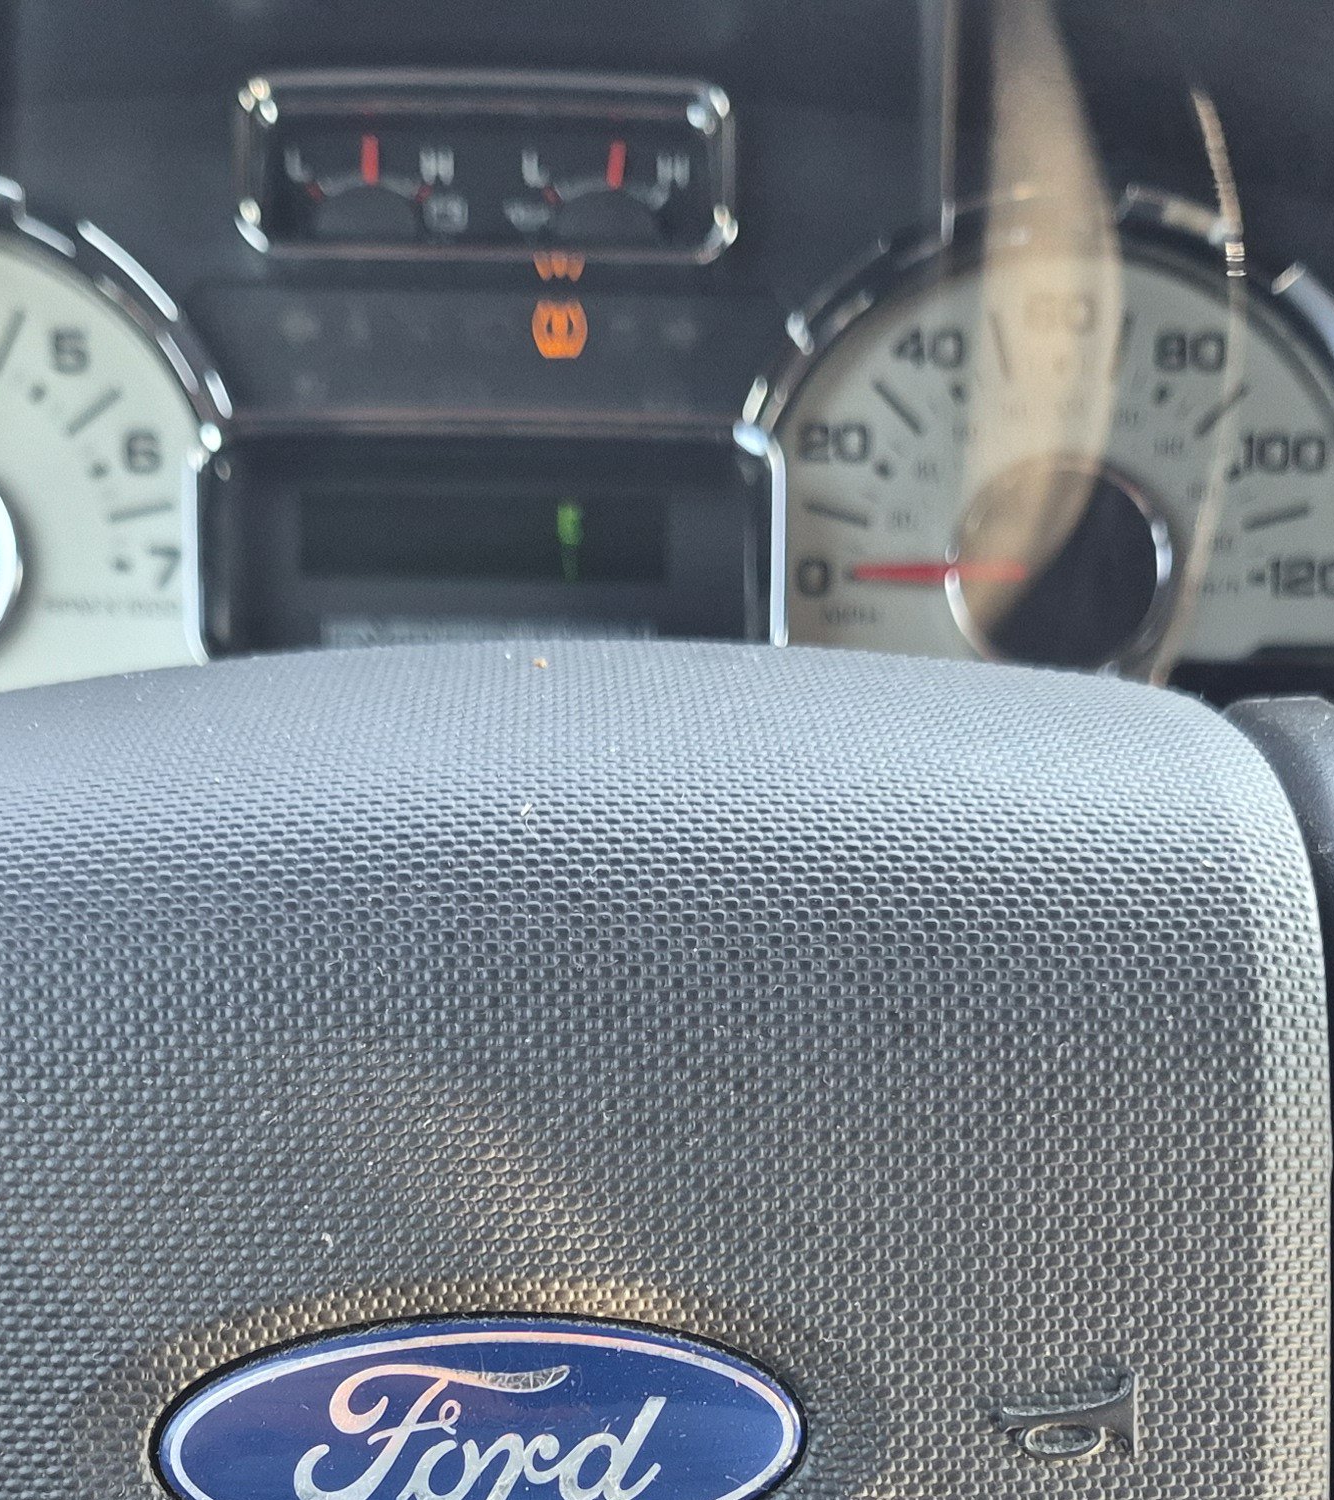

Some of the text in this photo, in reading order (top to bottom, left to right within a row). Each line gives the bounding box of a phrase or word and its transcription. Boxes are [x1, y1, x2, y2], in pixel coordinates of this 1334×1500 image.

[48, 324, 91, 375] 5
[891, 325, 966, 371] 40
[1153, 329, 1227, 374] 80
[123, 427, 163, 476] 6
[797, 419, 872, 464] 20
[1243, 432, 1327, 474] 100
[148, 542, 182, 590] 7
[796, 556, 833, 600] 0
